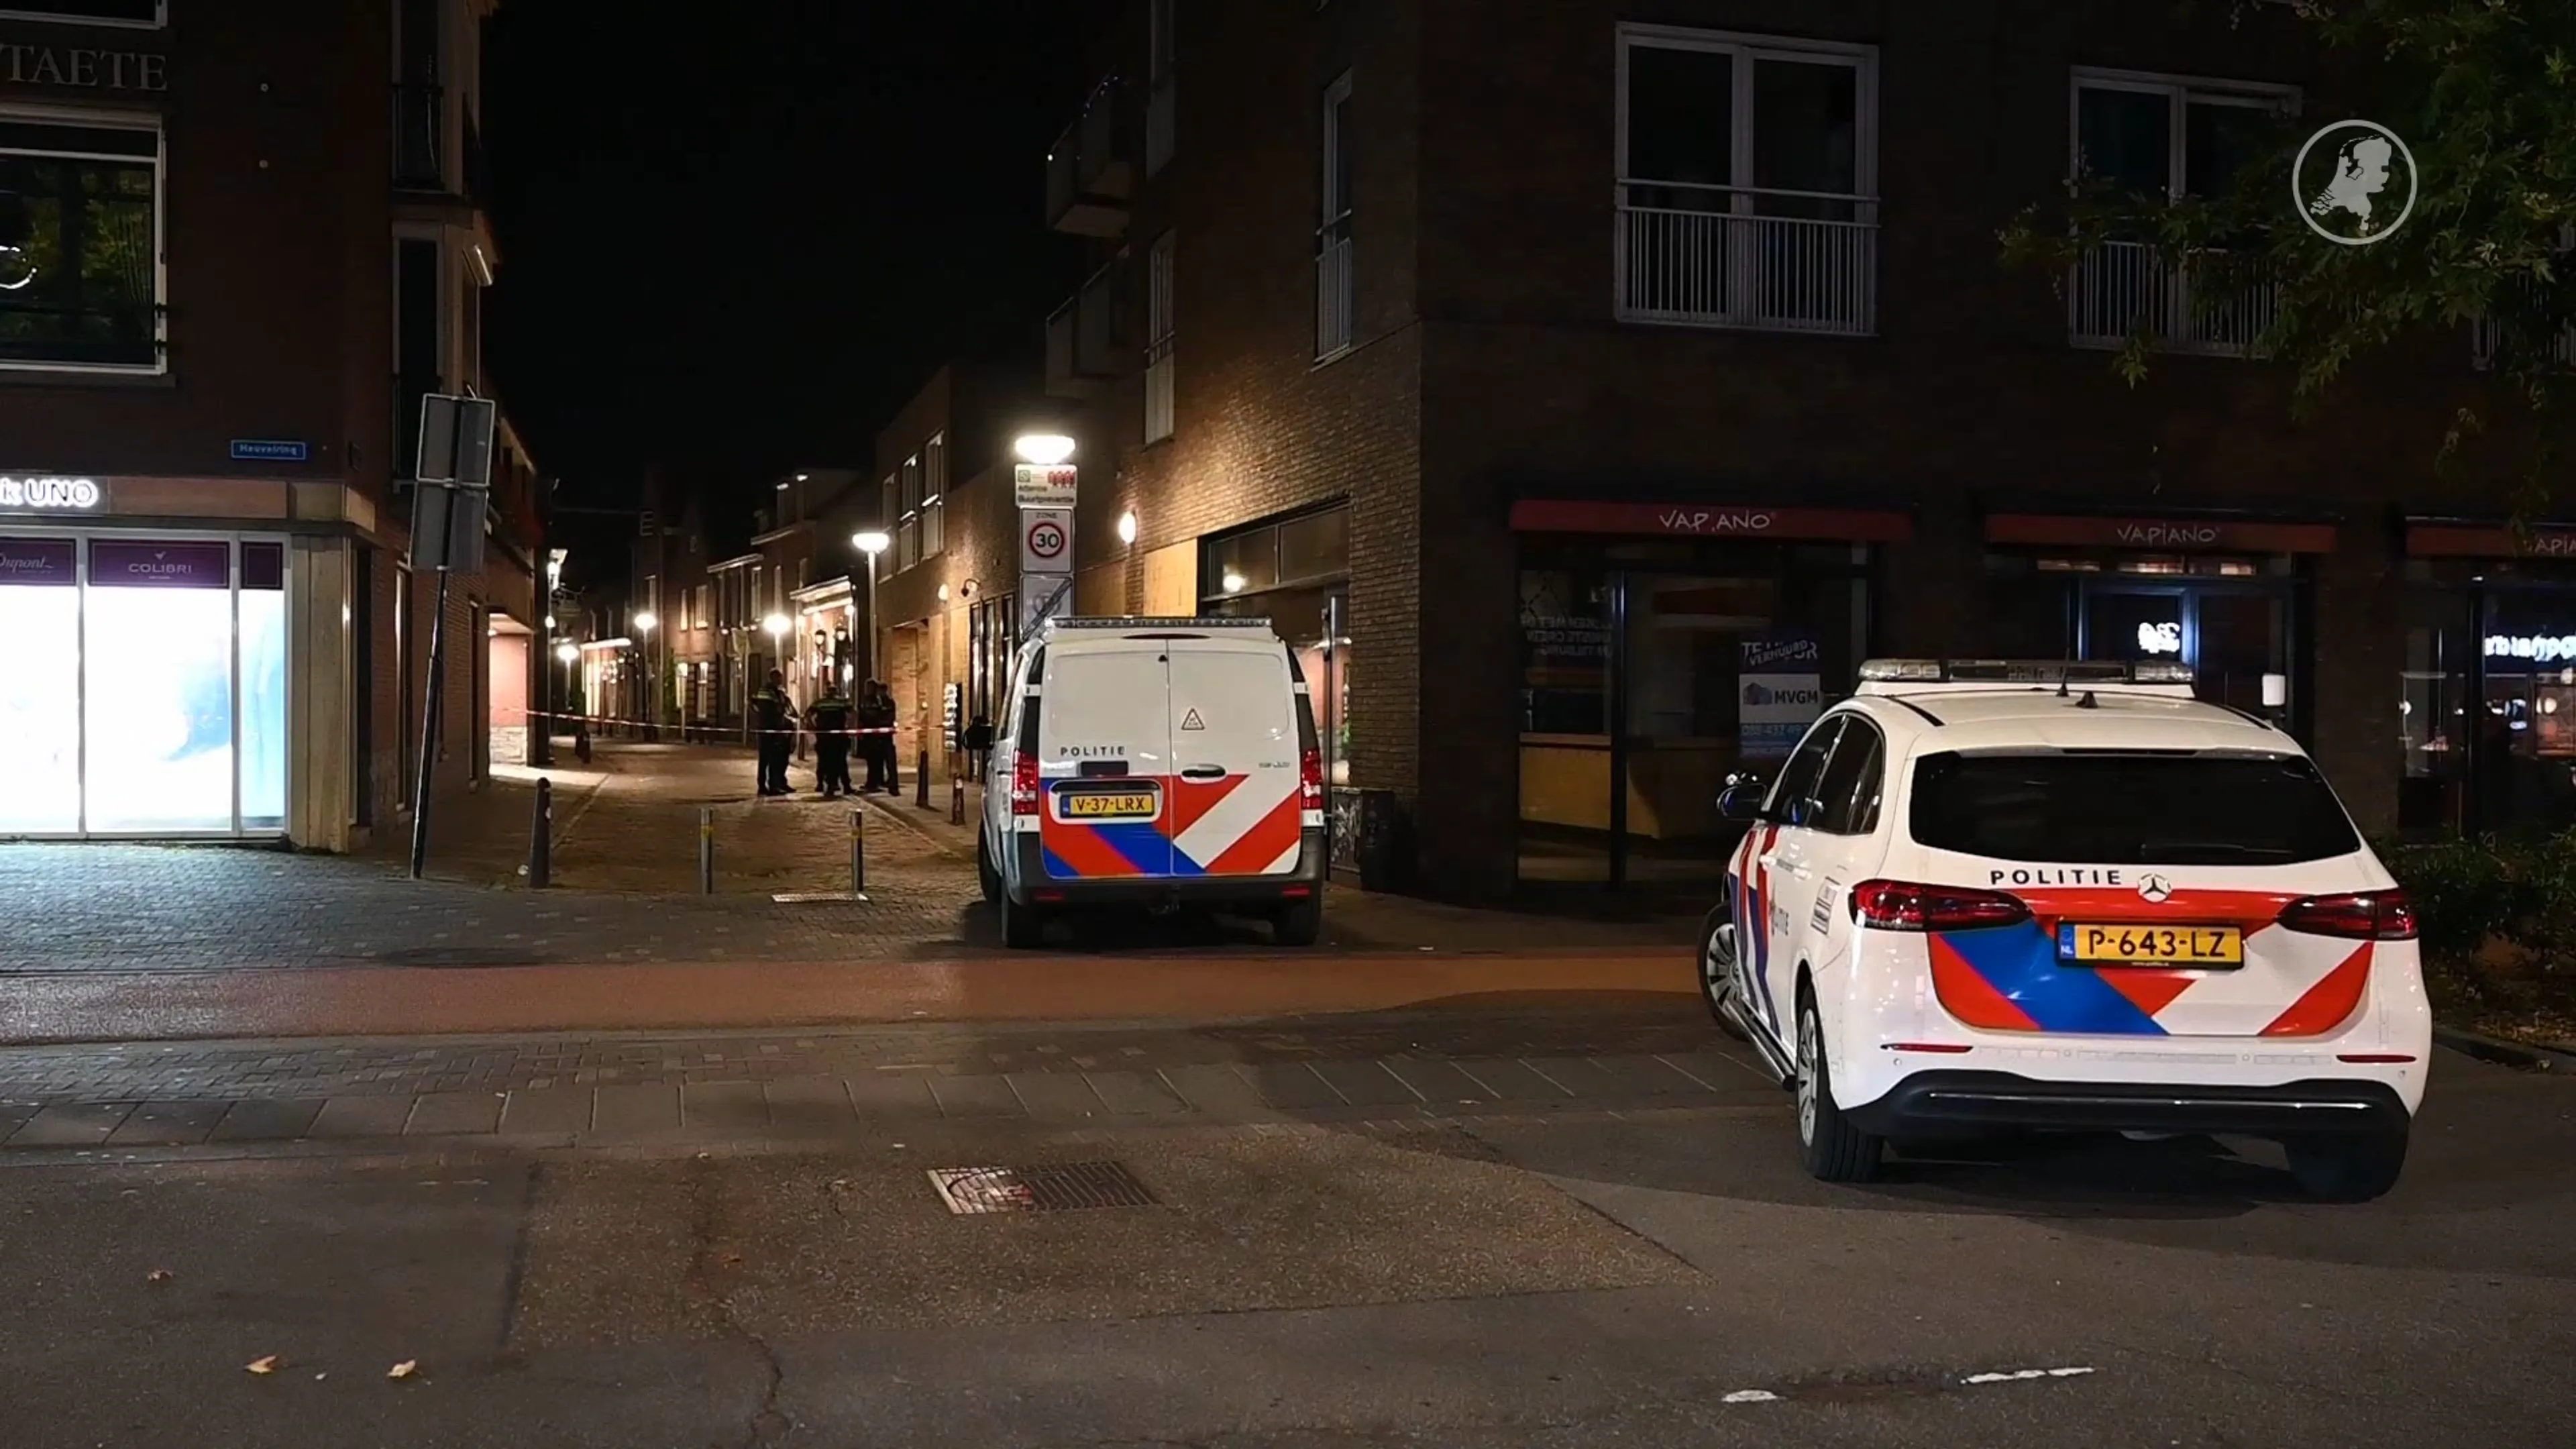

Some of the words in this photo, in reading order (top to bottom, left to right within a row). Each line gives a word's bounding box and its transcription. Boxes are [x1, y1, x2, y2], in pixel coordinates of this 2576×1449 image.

[26, 479, 97, 506] UNO
[1035, 533, 1059, 549] 30
[128, 563, 192, 574] COLIBRI
[1774, 690, 1819, 704] MVGM
[1060, 746, 1125, 756] POLITIE
[1075, 796, 1145, 812] V-37-LRX
[1990, 869, 2122, 885] POLITIE
[2060, 944, 2074, 955] NL
[2088, 929, 2226, 957] P-643-LZ
